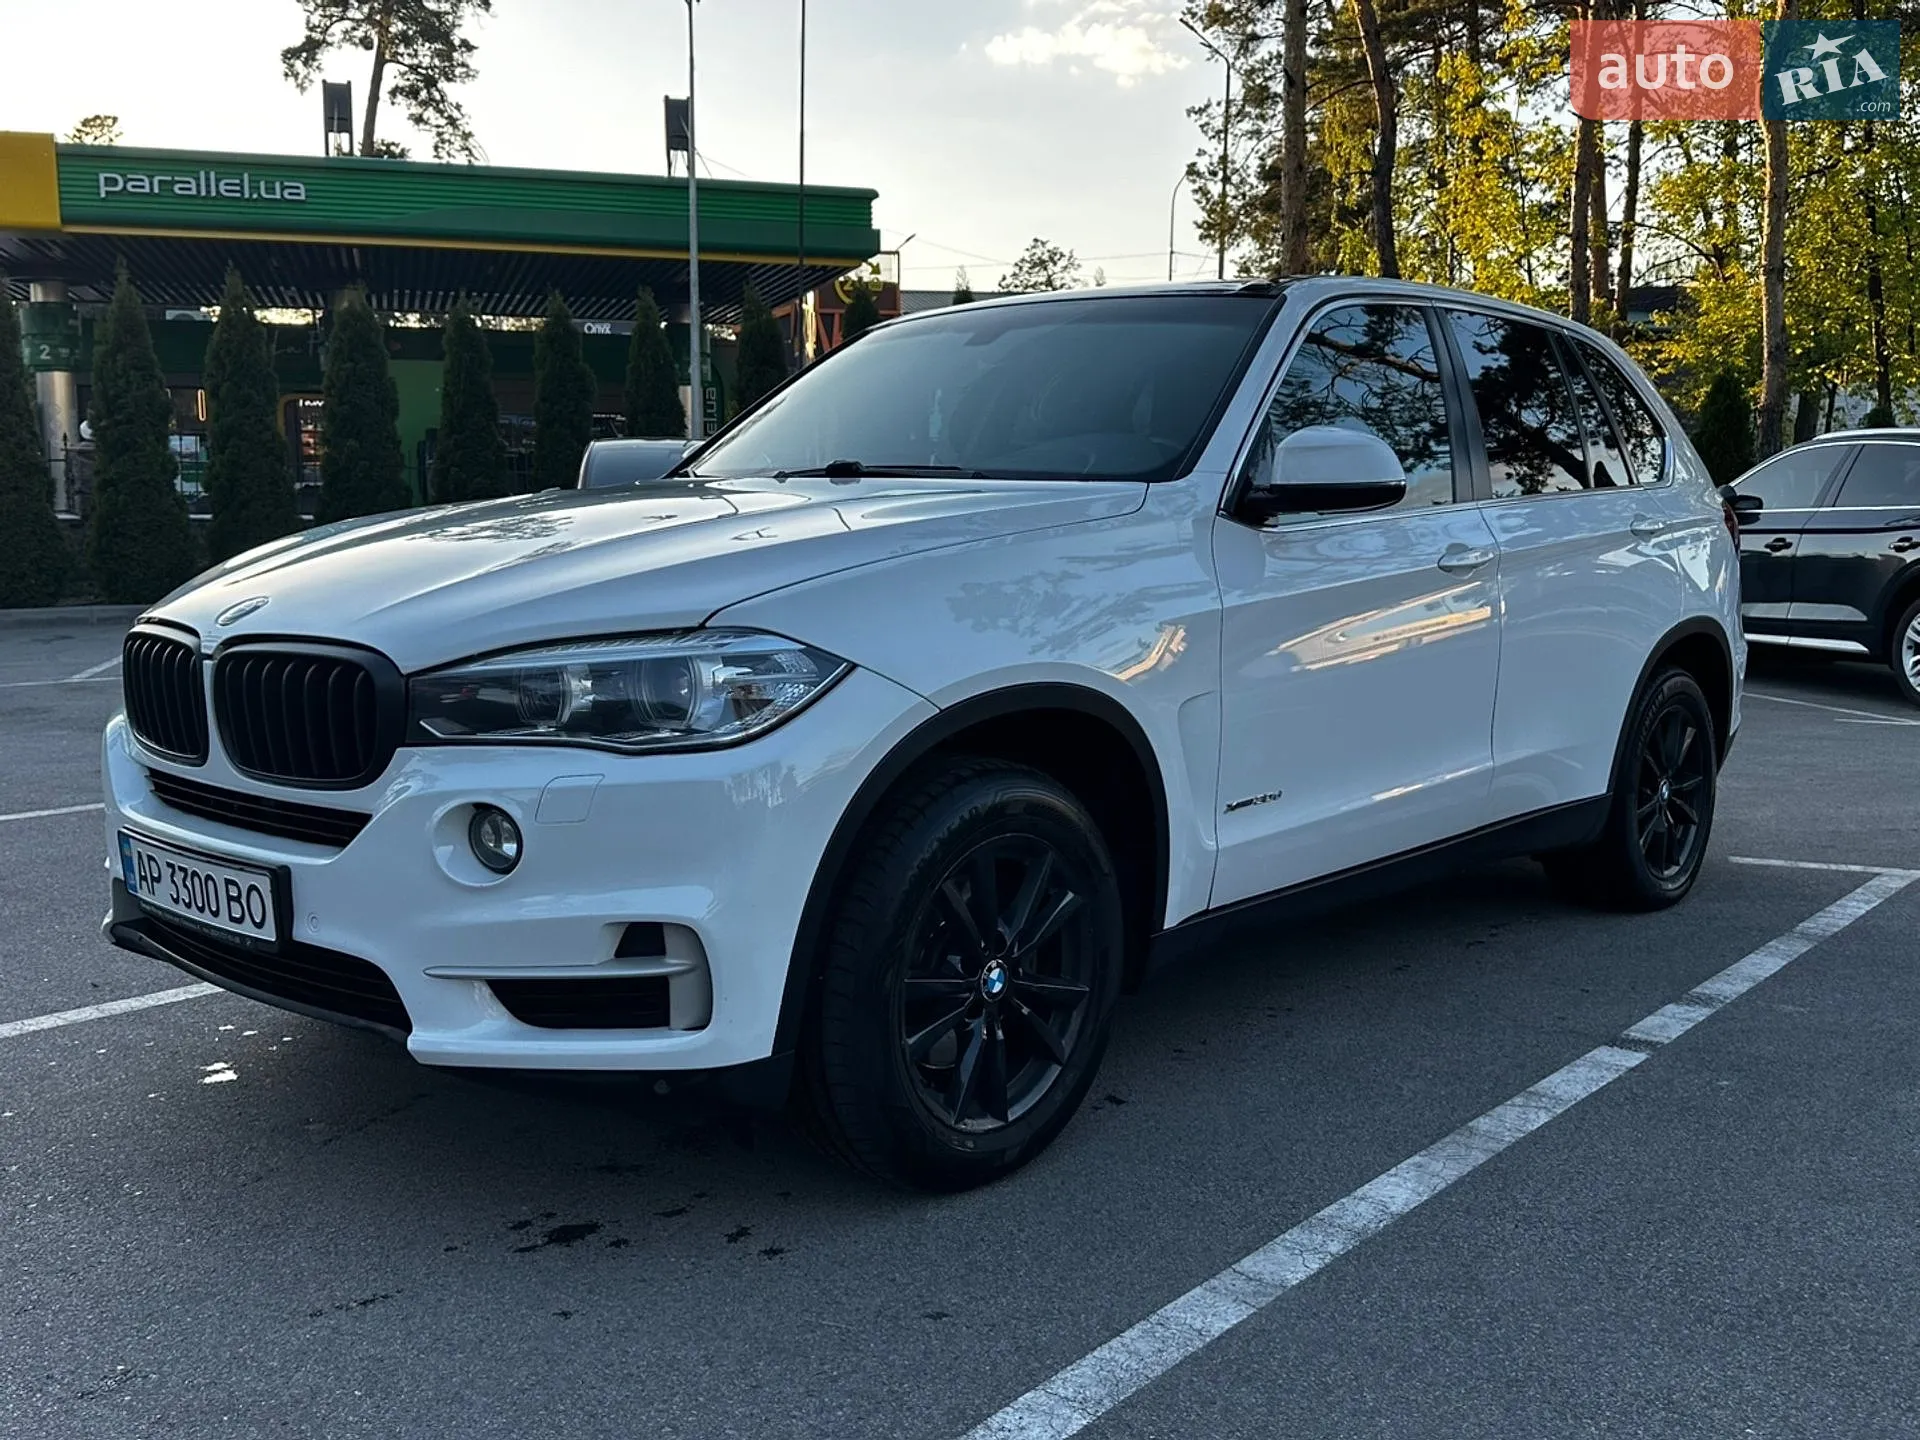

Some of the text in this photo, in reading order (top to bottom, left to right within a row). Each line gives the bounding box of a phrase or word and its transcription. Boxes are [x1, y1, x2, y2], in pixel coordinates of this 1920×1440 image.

[98, 169, 307, 202] parallel.ua
[39, 343, 52, 361] 2
[136, 849, 162, 897] AP
[165, 859, 221, 919] 3300
[223, 877, 267, 930] BO
